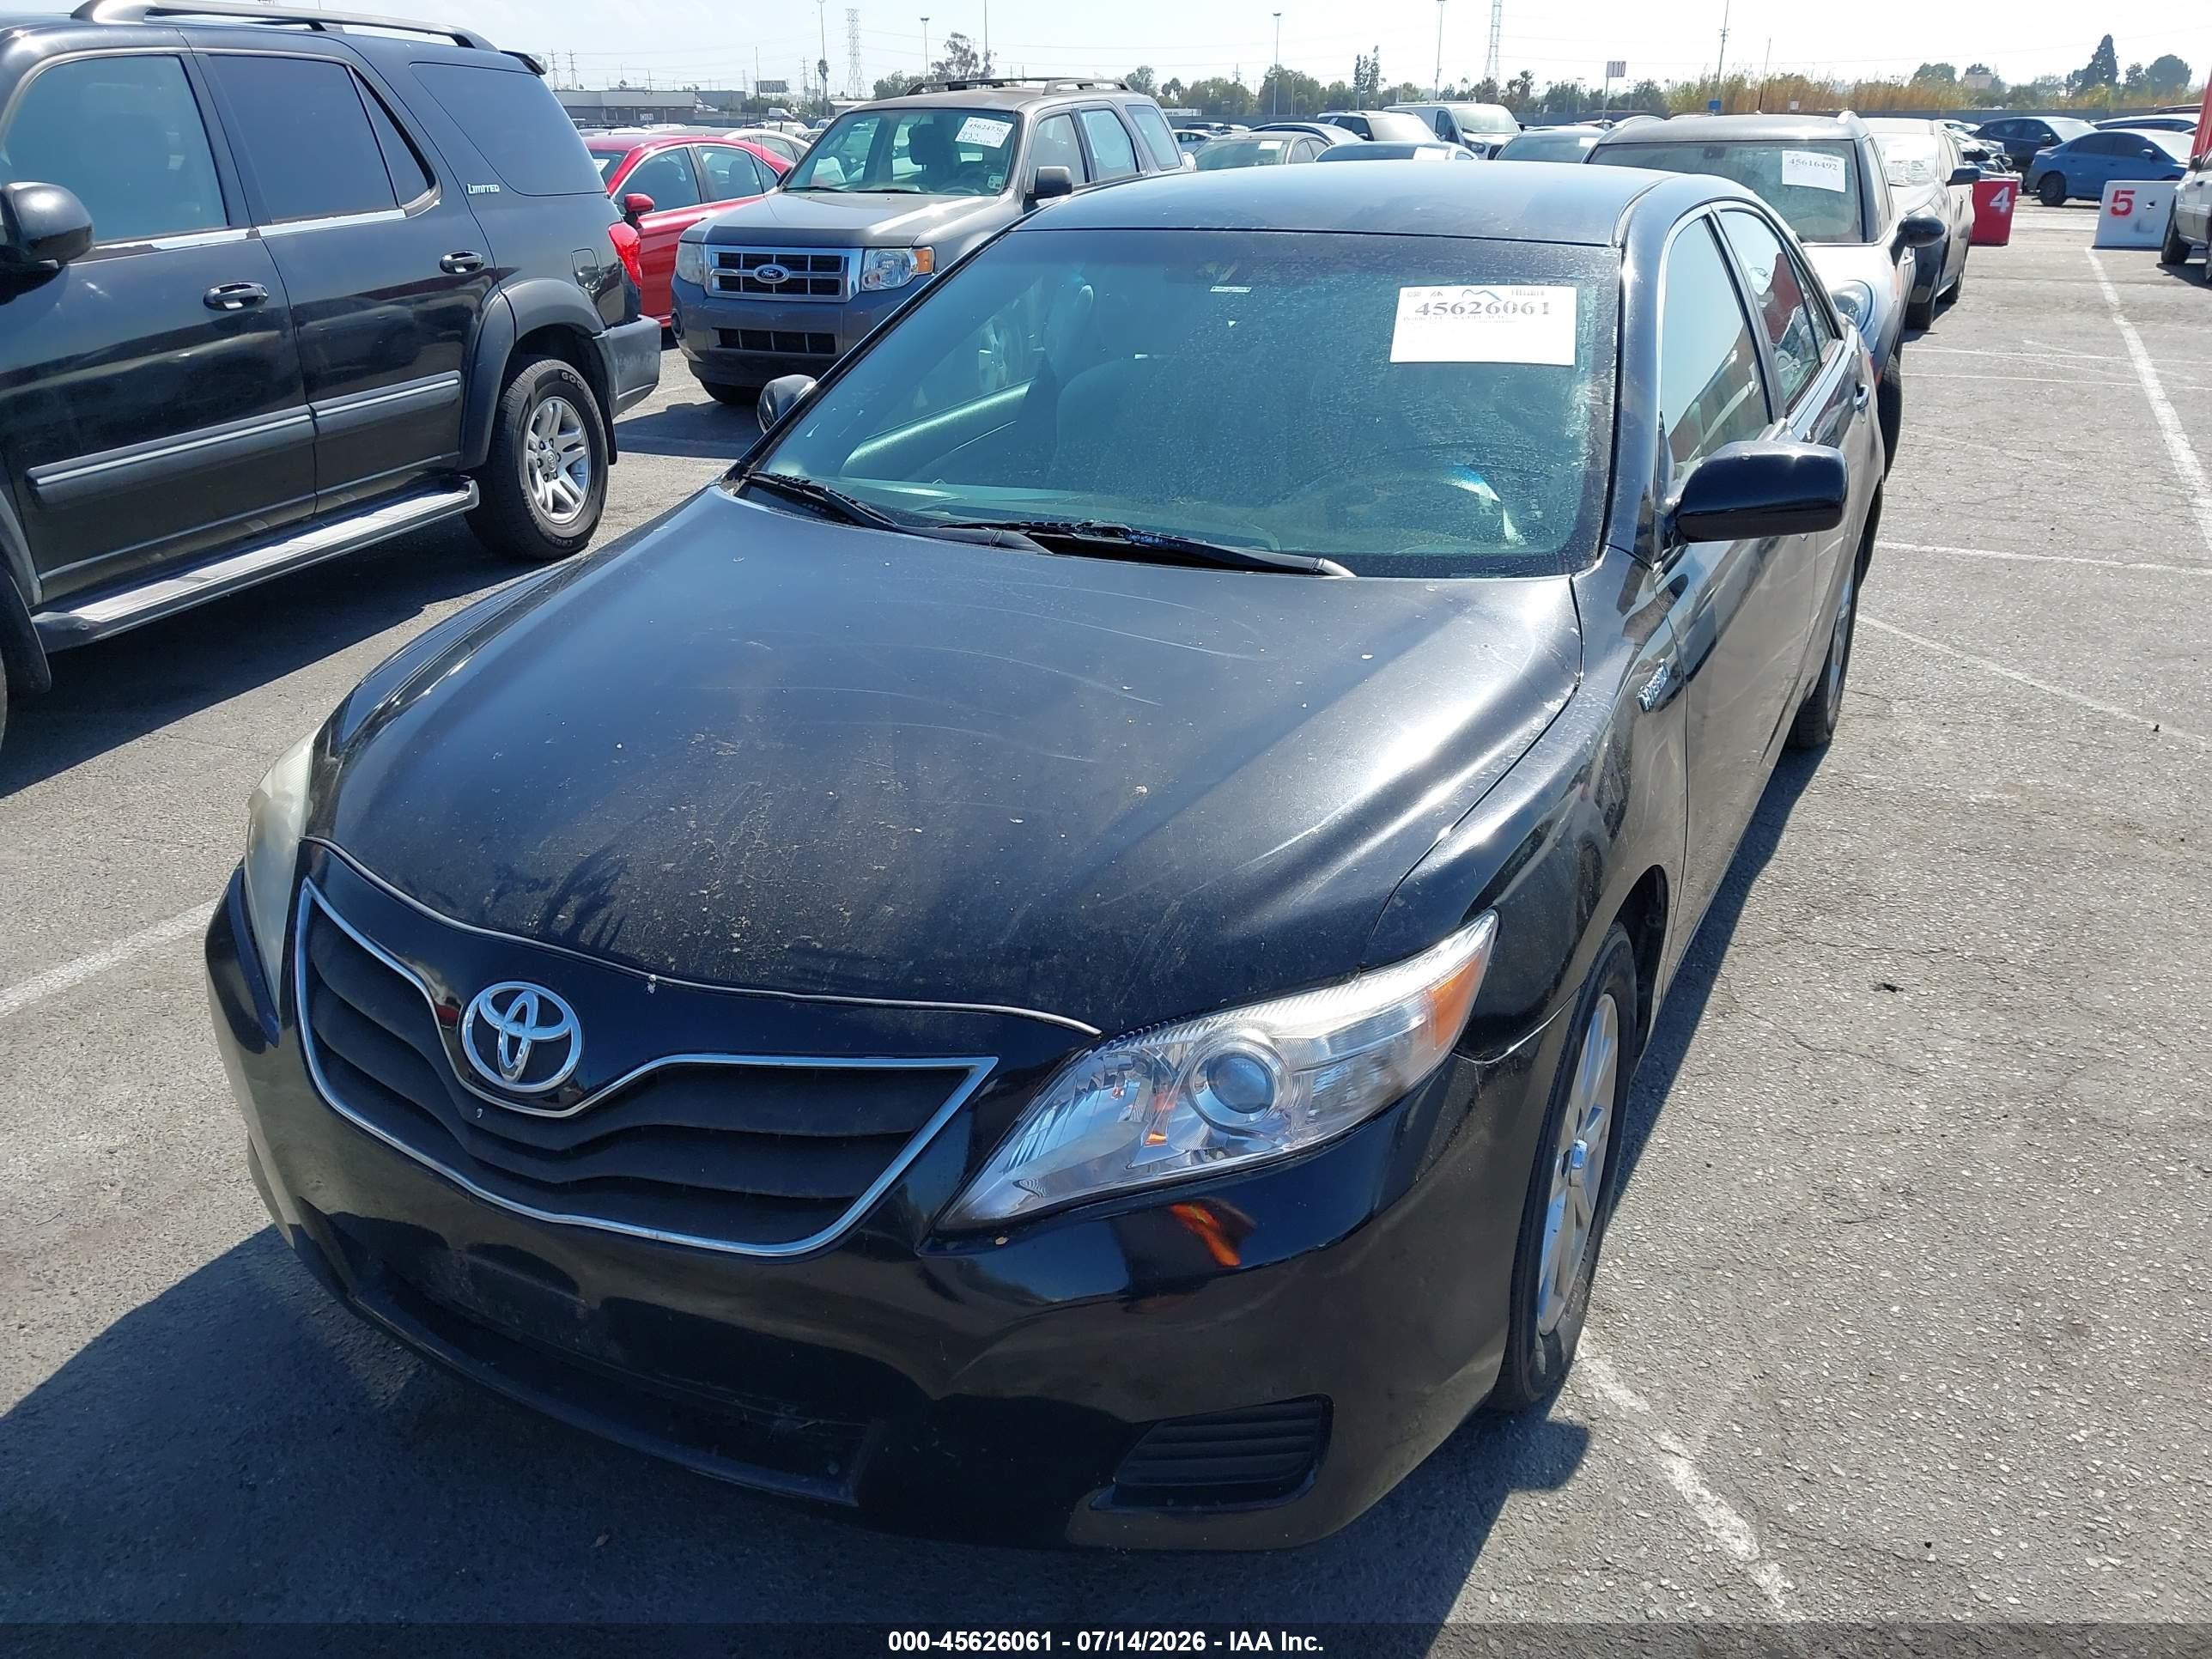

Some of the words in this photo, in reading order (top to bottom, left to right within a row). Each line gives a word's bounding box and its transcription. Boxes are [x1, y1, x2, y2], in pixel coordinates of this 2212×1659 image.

[1786, 157, 1838, 171] 45616492
[1988, 185, 2011, 213] 4
[2109, 189, 2136, 216] 5
[1414, 301, 1551, 317] 45626061
